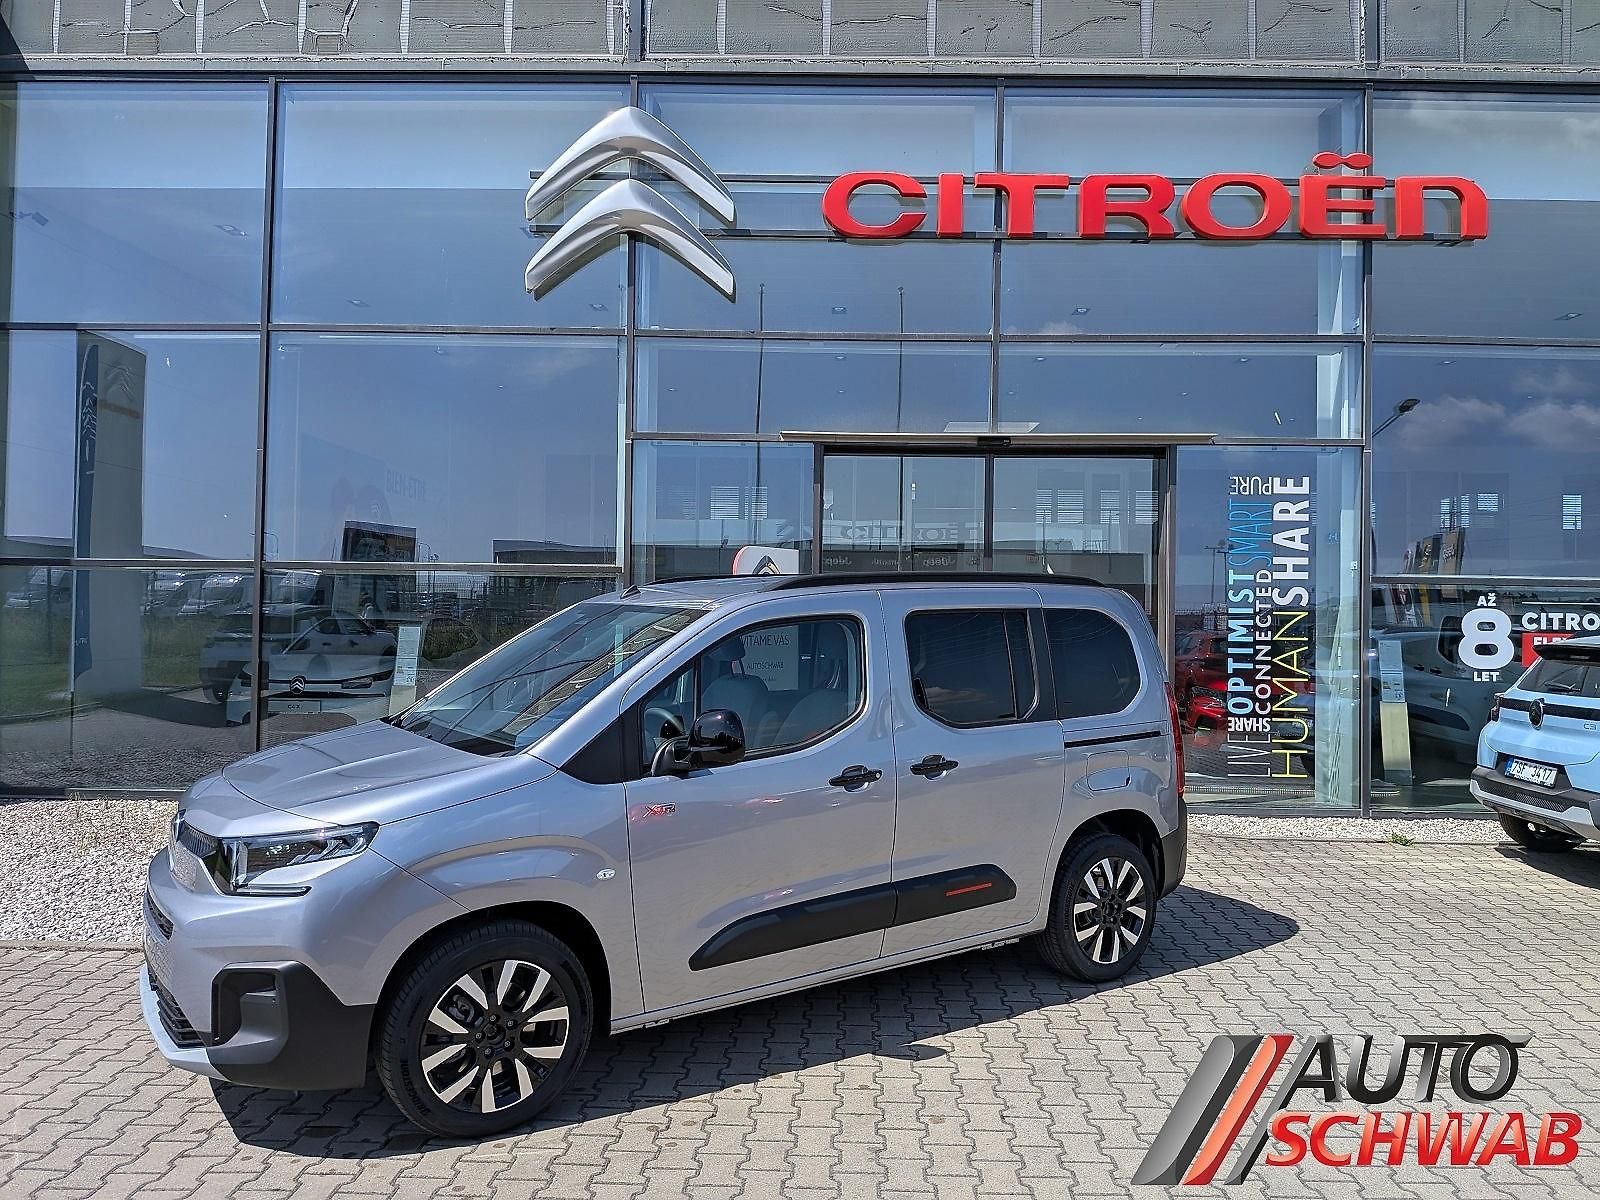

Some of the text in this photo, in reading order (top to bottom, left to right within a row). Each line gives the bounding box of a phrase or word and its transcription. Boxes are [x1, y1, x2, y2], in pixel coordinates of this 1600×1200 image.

[822, 151, 1489, 241] CITROËN
[1229, 476, 1272, 495] PURE
[1228, 499, 1273, 567] SMART
[1272, 476, 1310, 607] SHARE
[1477, 593, 1497, 607] AŽ
[1227, 569, 1255, 713] OPTIMIST
[1255, 569, 1272, 715] CONNECTED
[1458, 608, 1515, 669] 8
[1272, 611, 1309, 777] HUMAN
[1474, 671, 1500, 682] LET
[1227, 717, 1271, 732] SHARE
[1227, 733, 1271, 777] LIVE
